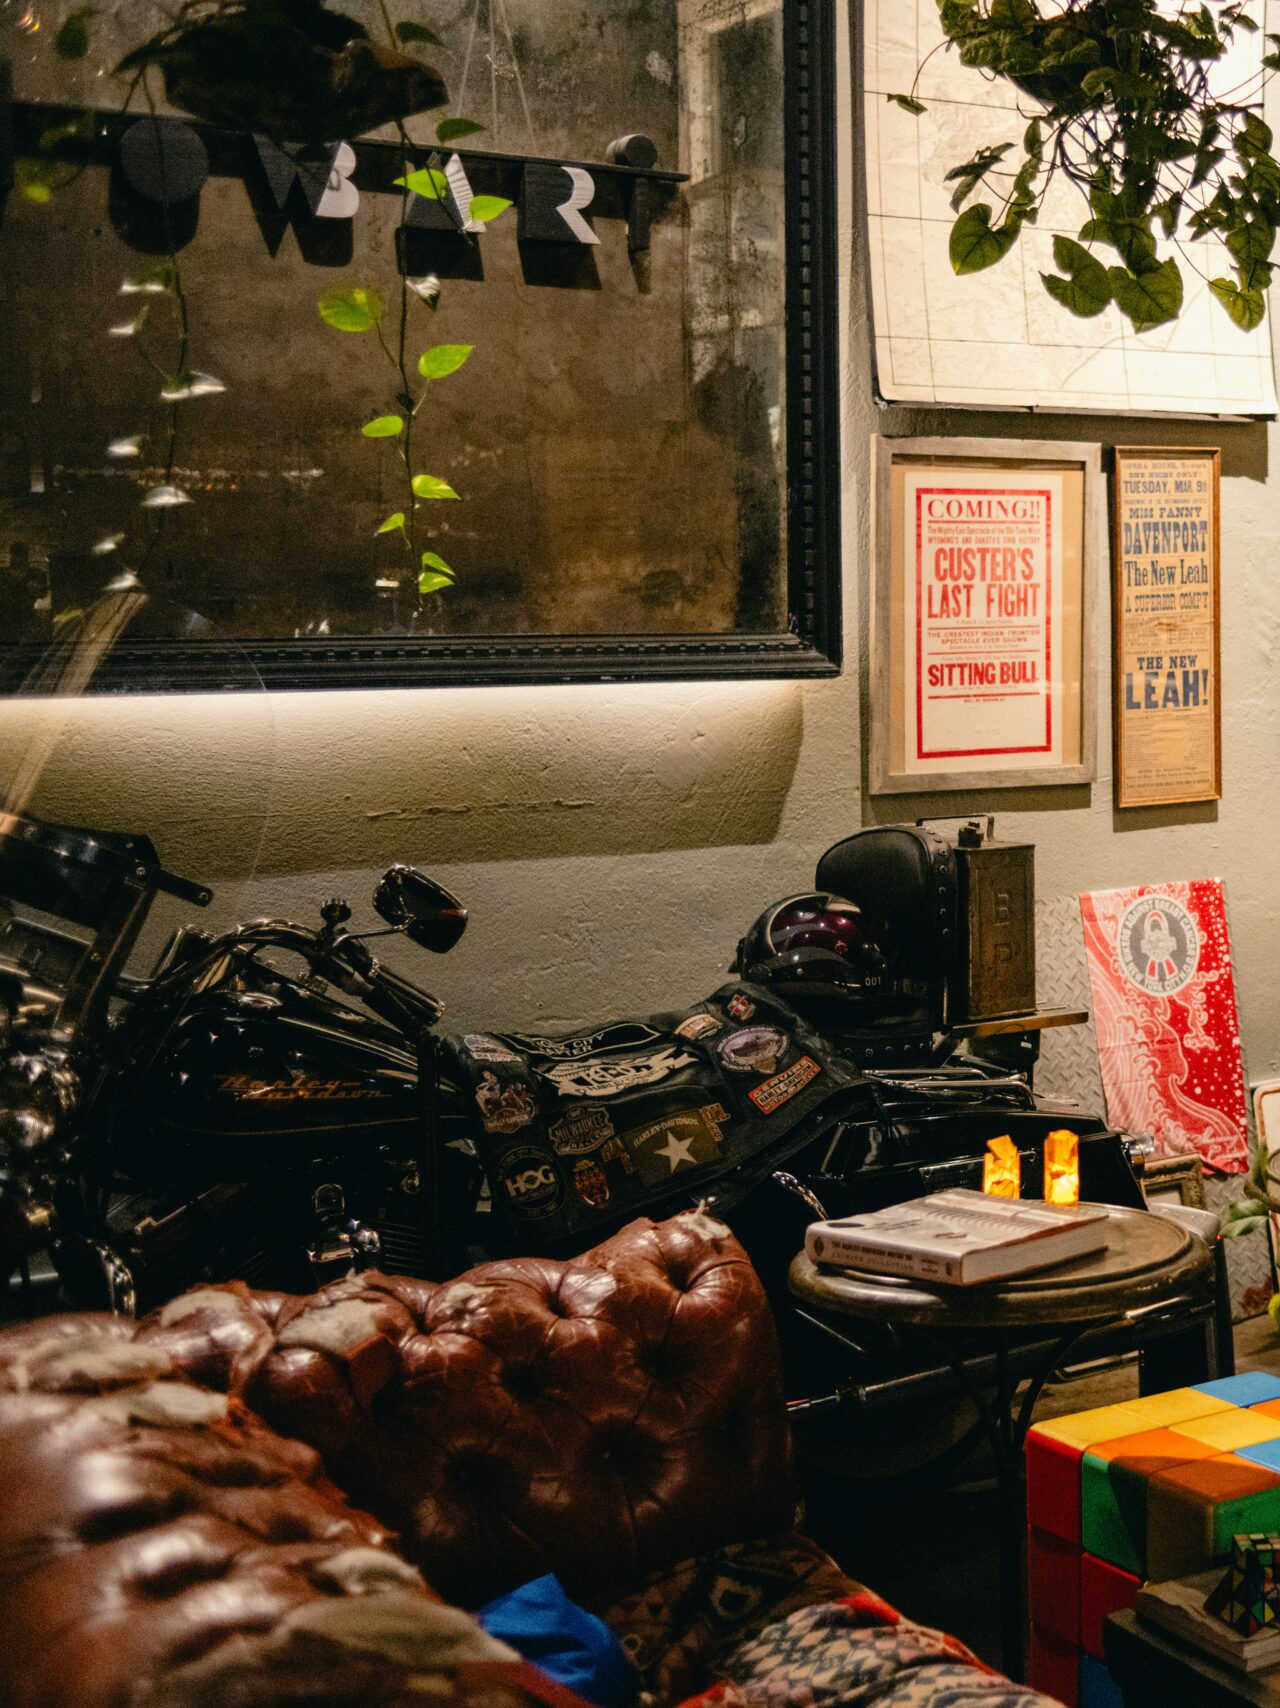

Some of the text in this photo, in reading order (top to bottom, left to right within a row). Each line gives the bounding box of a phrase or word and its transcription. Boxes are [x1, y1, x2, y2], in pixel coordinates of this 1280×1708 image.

[927, 499, 1040, 519] COMING!!
[1128, 506, 1202, 519] MISS FANNY
[1123, 520, 1208, 555] DAVENPORT
[935, 547, 1034, 582] CUSTER'S
[1124, 558, 1209, 587] The New Leah
[927, 583, 1040, 619] LAST FIGHT
[927, 661, 1040, 687] SITTING BULL
[1137, 655, 1198, 671] THE NEW
[1125, 669, 1209, 710] LEAH!
[573, 1033, 605, 1048] CITY
[505, 1164, 556, 1198] HOG
